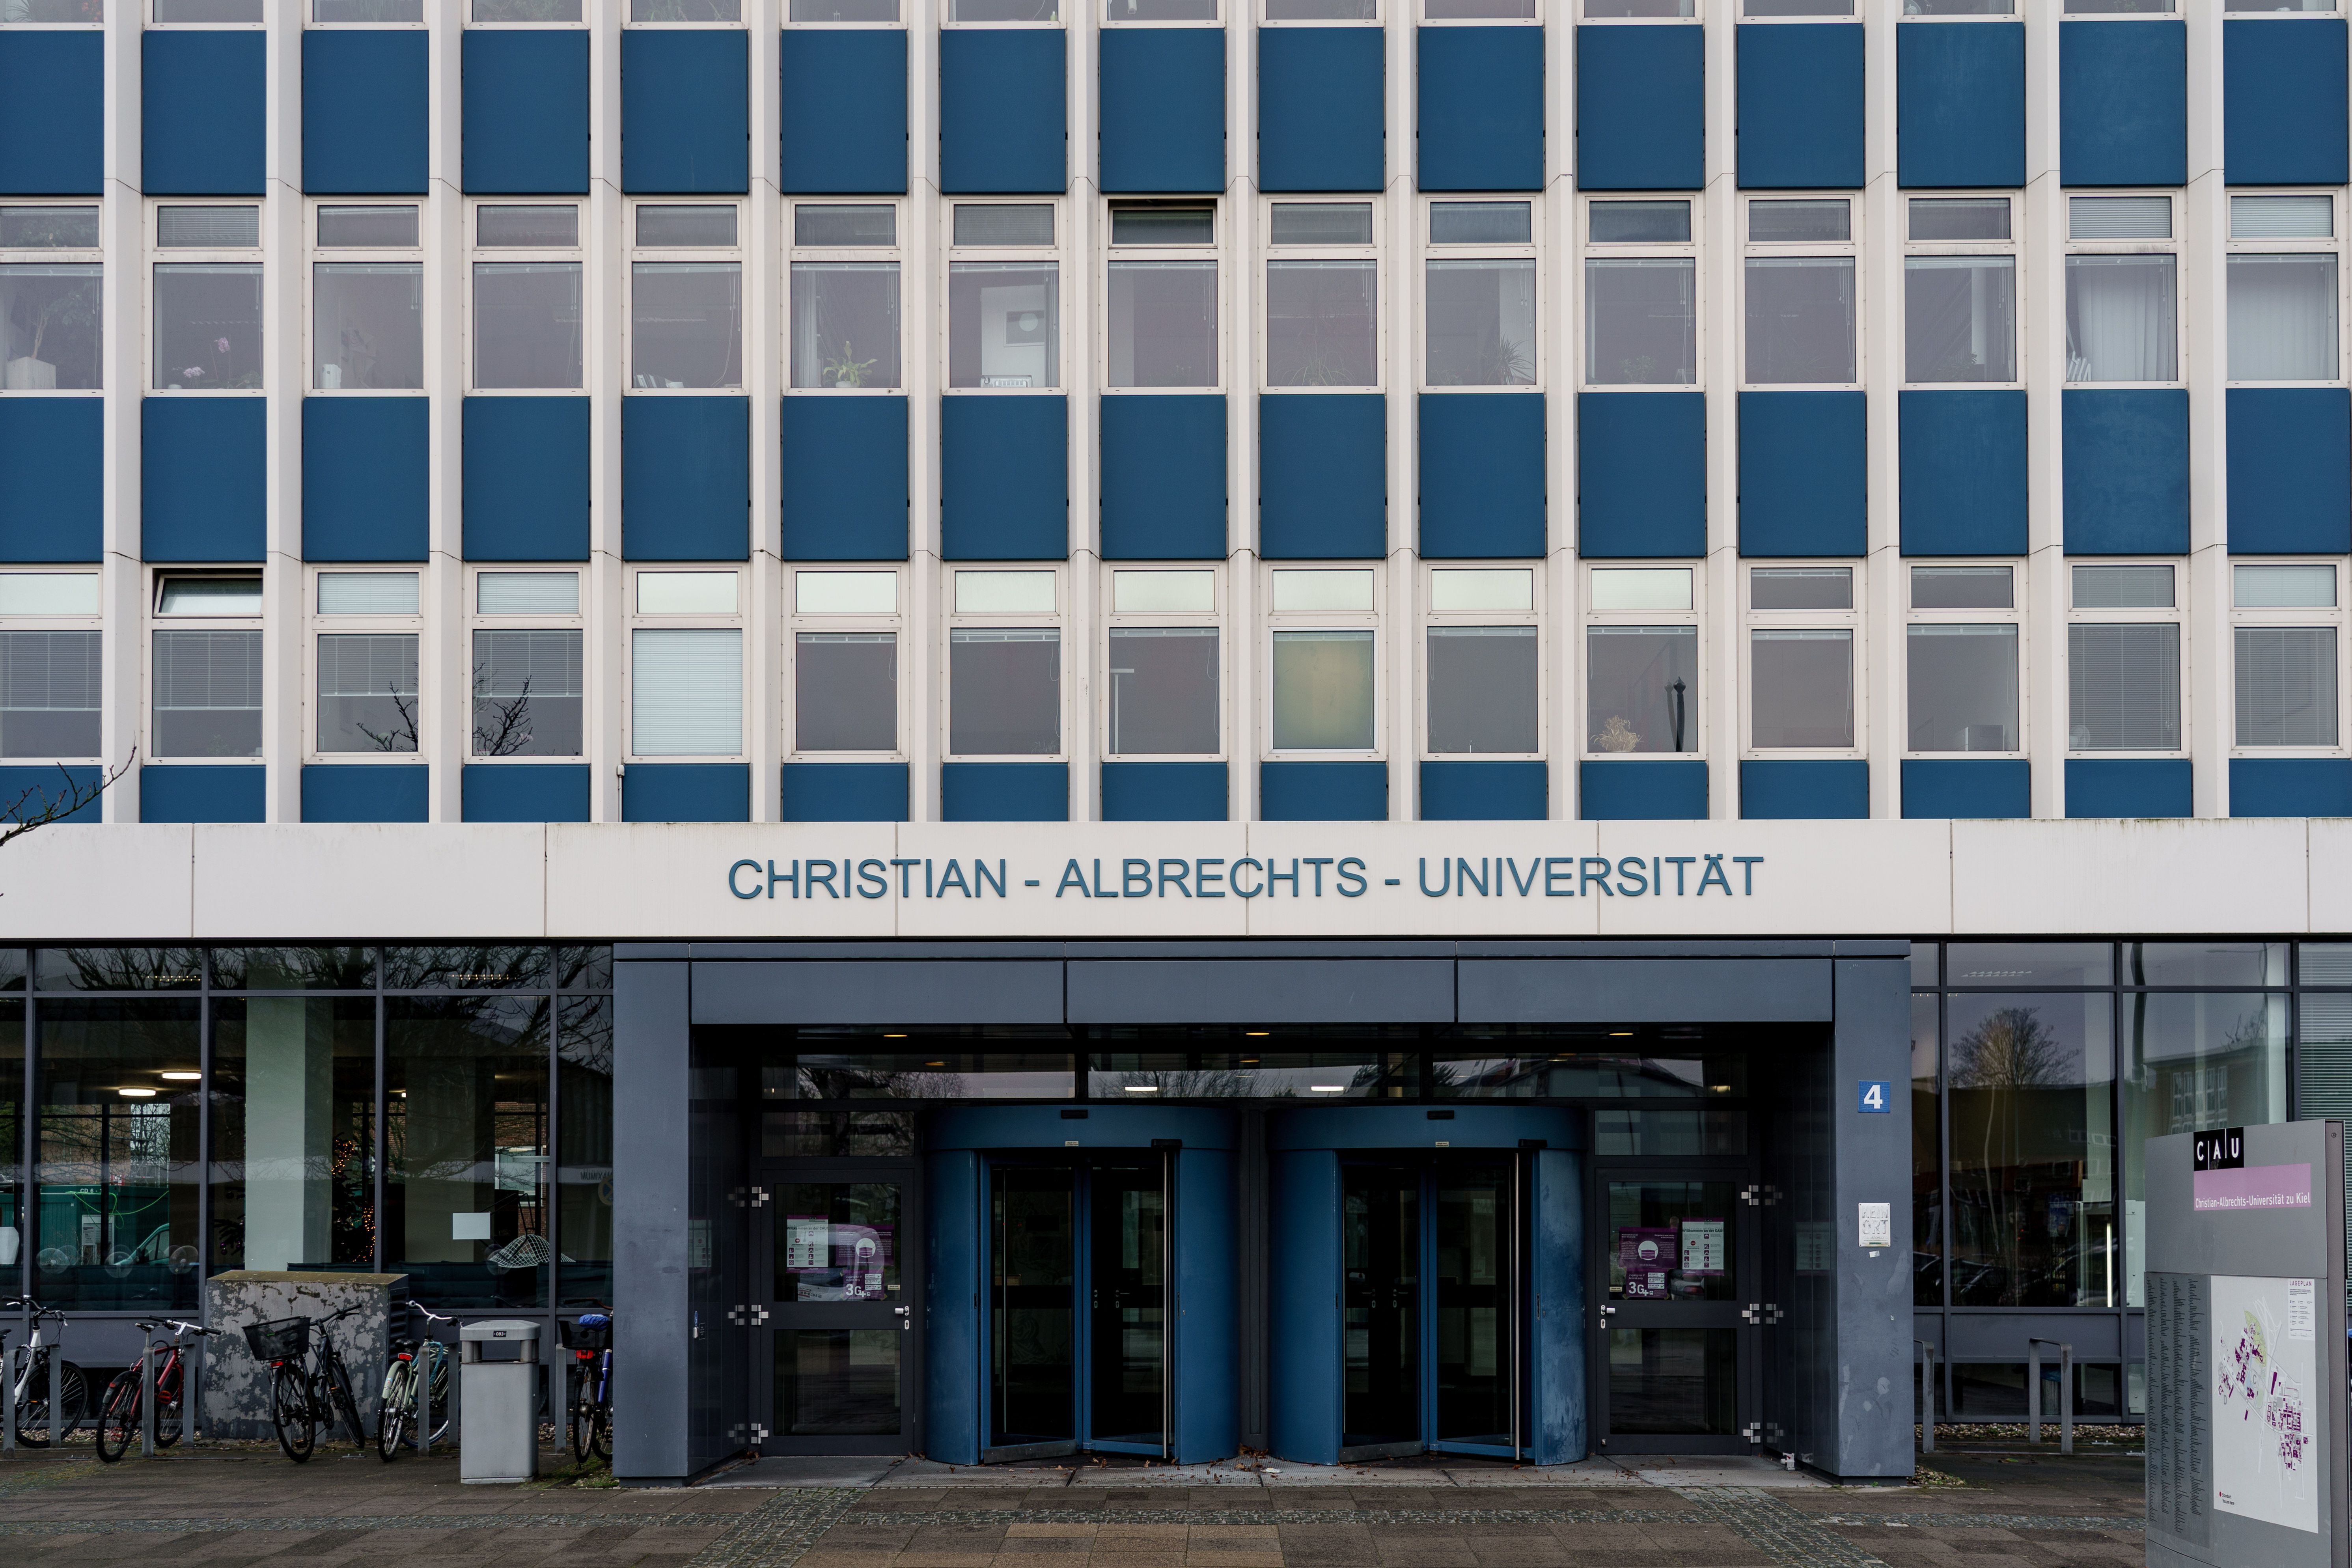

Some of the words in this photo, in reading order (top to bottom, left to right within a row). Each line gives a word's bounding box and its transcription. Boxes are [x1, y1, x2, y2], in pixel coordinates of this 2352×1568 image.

[729, 859, 1006, 899] CHRISTIAN
[1056, 857, 1367, 897] ALBRECHTS
[1419, 854, 1764, 896] UNIVERSITÄT
[1864, 1085, 1883, 1109] 4
[2195, 1193, 2284, 1208] Christian-Albrechts-Universität
[2286, 1196, 2294, 1204] zu
[2296, 1192, 2311, 1204] Kiel
[2253, 1374, 2257, 1384] C
[2223, 1395, 2227, 1405] D
[2273, 1401, 2277, 1411] B
[2278, 1447, 2282, 1457] A
